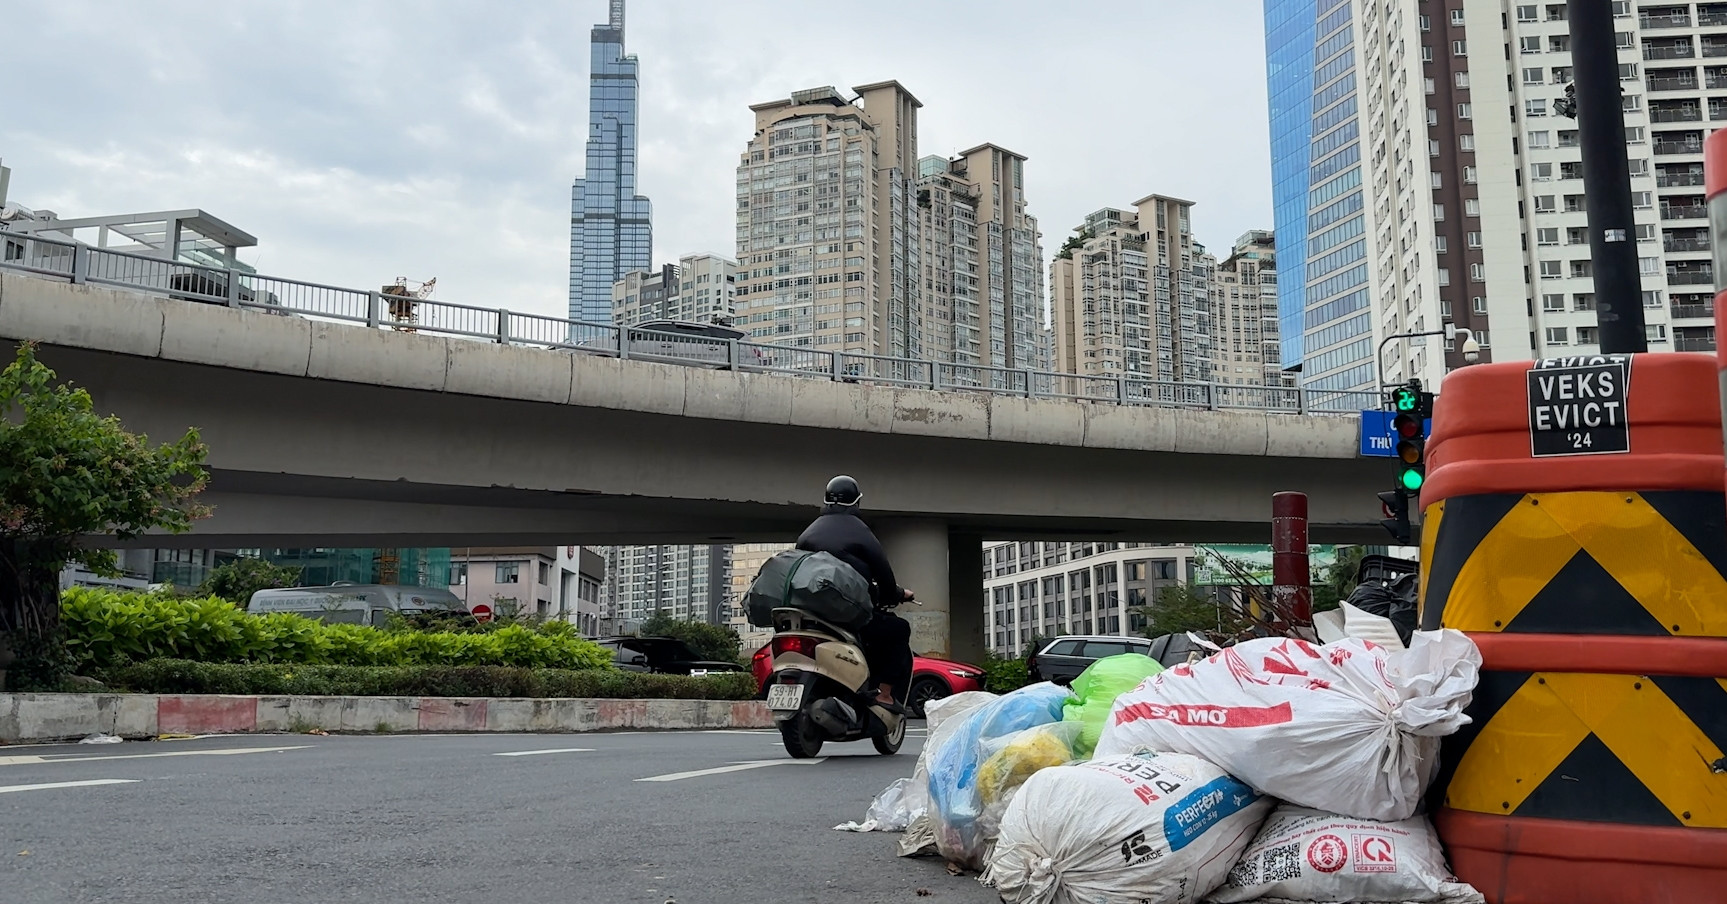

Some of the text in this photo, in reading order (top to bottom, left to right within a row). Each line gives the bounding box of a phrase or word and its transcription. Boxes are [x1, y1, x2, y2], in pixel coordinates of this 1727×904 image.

[1538, 371, 1615, 401] VEKS
[1535, 401, 1620, 431] EVICT
[768, 698, 799, 708] 074.02
